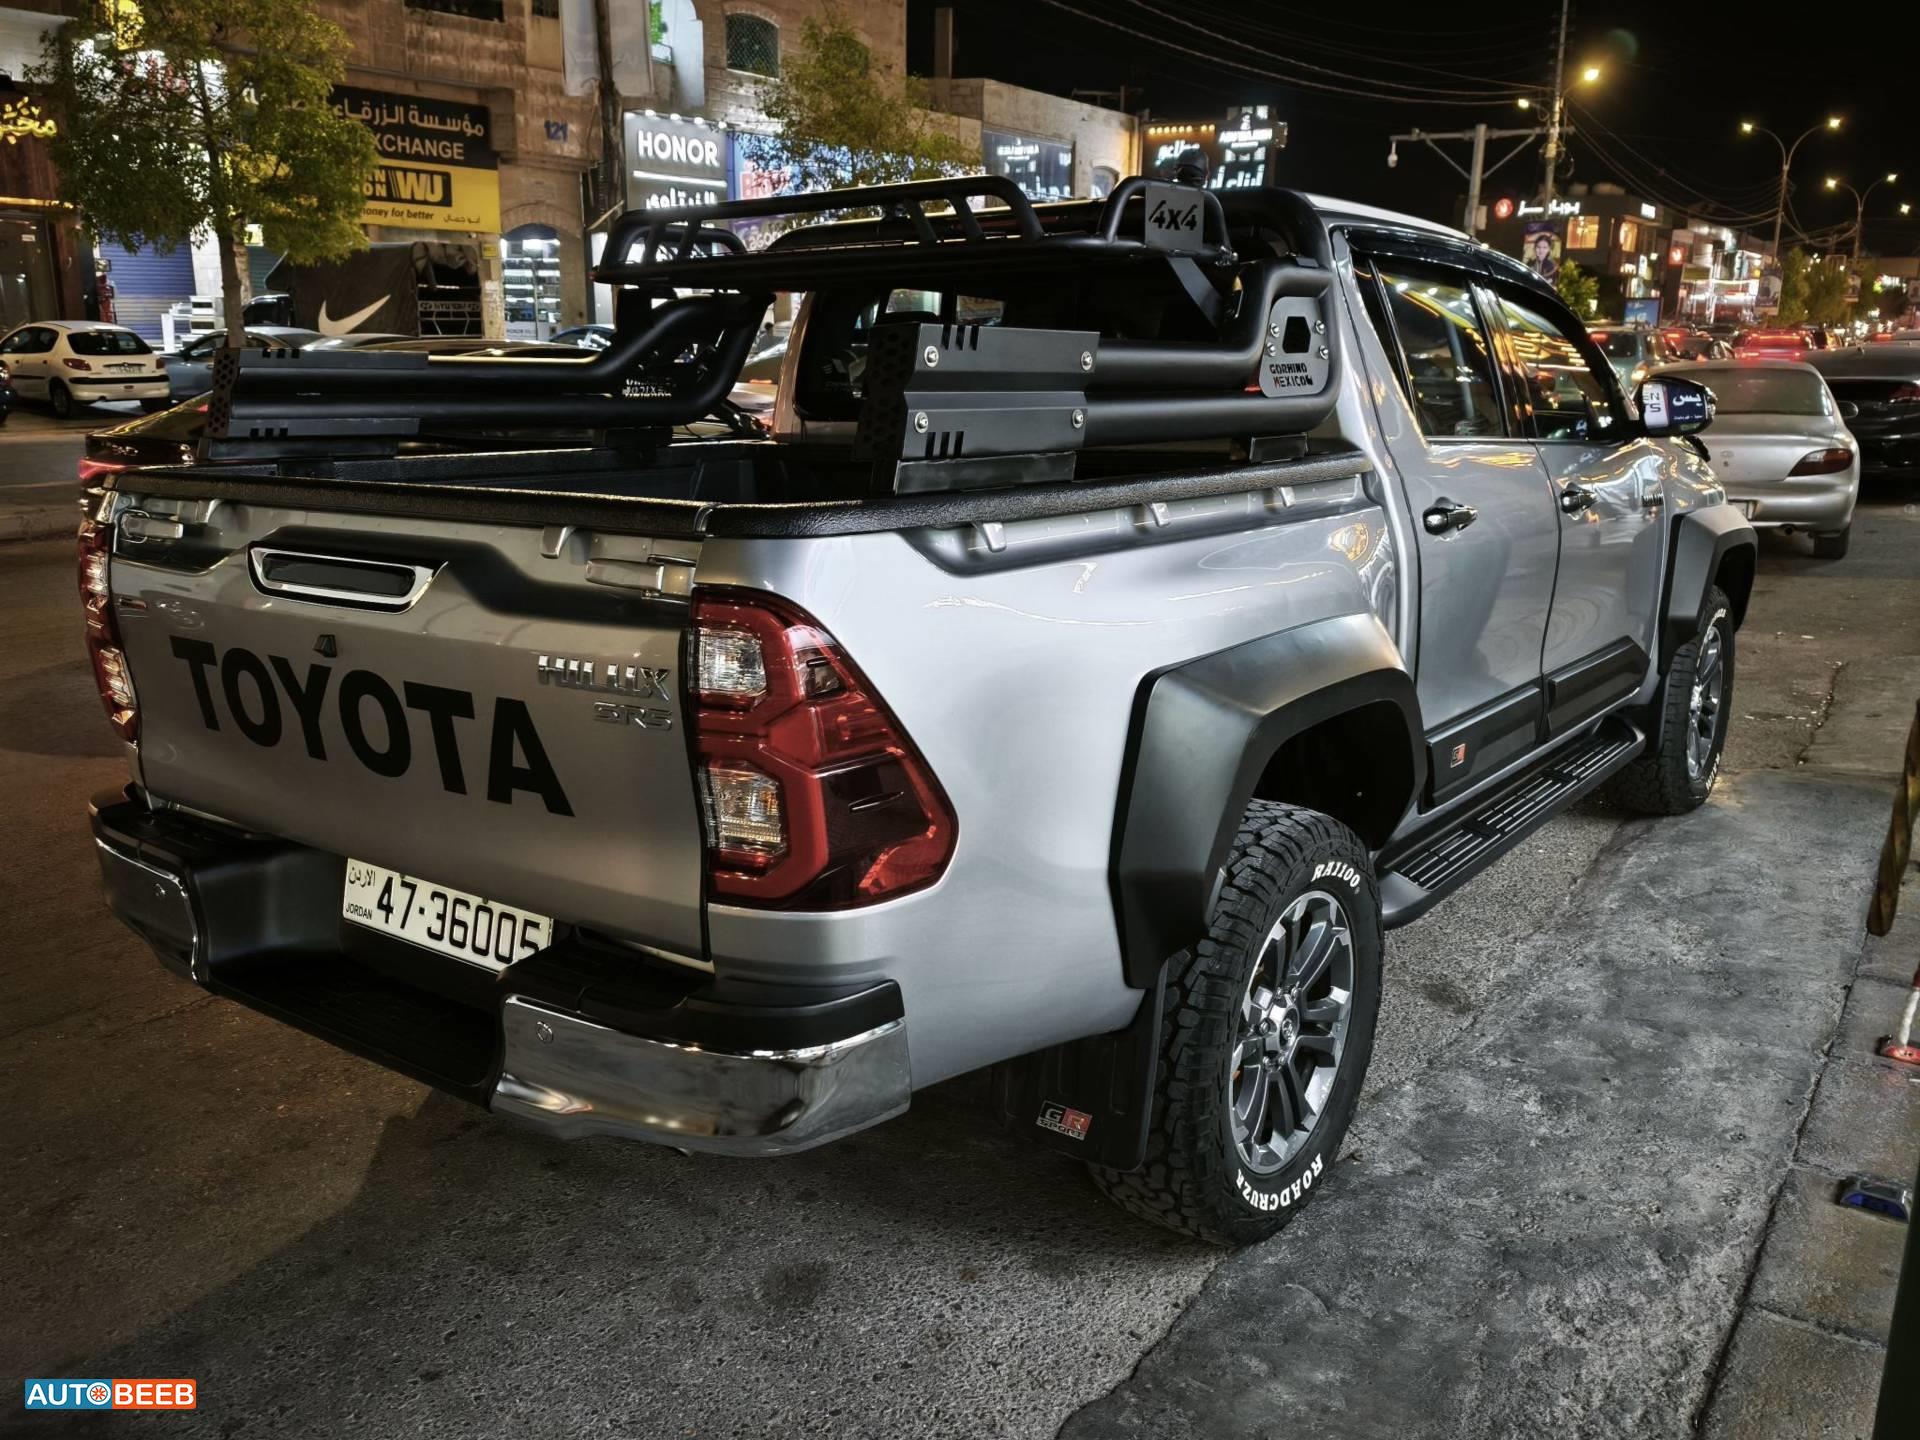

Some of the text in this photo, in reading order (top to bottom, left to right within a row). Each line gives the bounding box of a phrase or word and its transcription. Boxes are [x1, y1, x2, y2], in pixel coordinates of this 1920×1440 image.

[408, 104, 484, 137] مؤسسة
[373, 133, 465, 160] XCHANGE
[637, 129, 721, 168] HONOR
[396, 170, 443, 202] WU
[391, 207, 404, 218] for
[406, 209, 434, 221] better
[538, 655, 671, 701] HILUX
[169, 635, 575, 818] TOYOTA
[345, 902, 373, 921] JORDAN
[1236, 1152, 1324, 1211] ROADCRUZA
